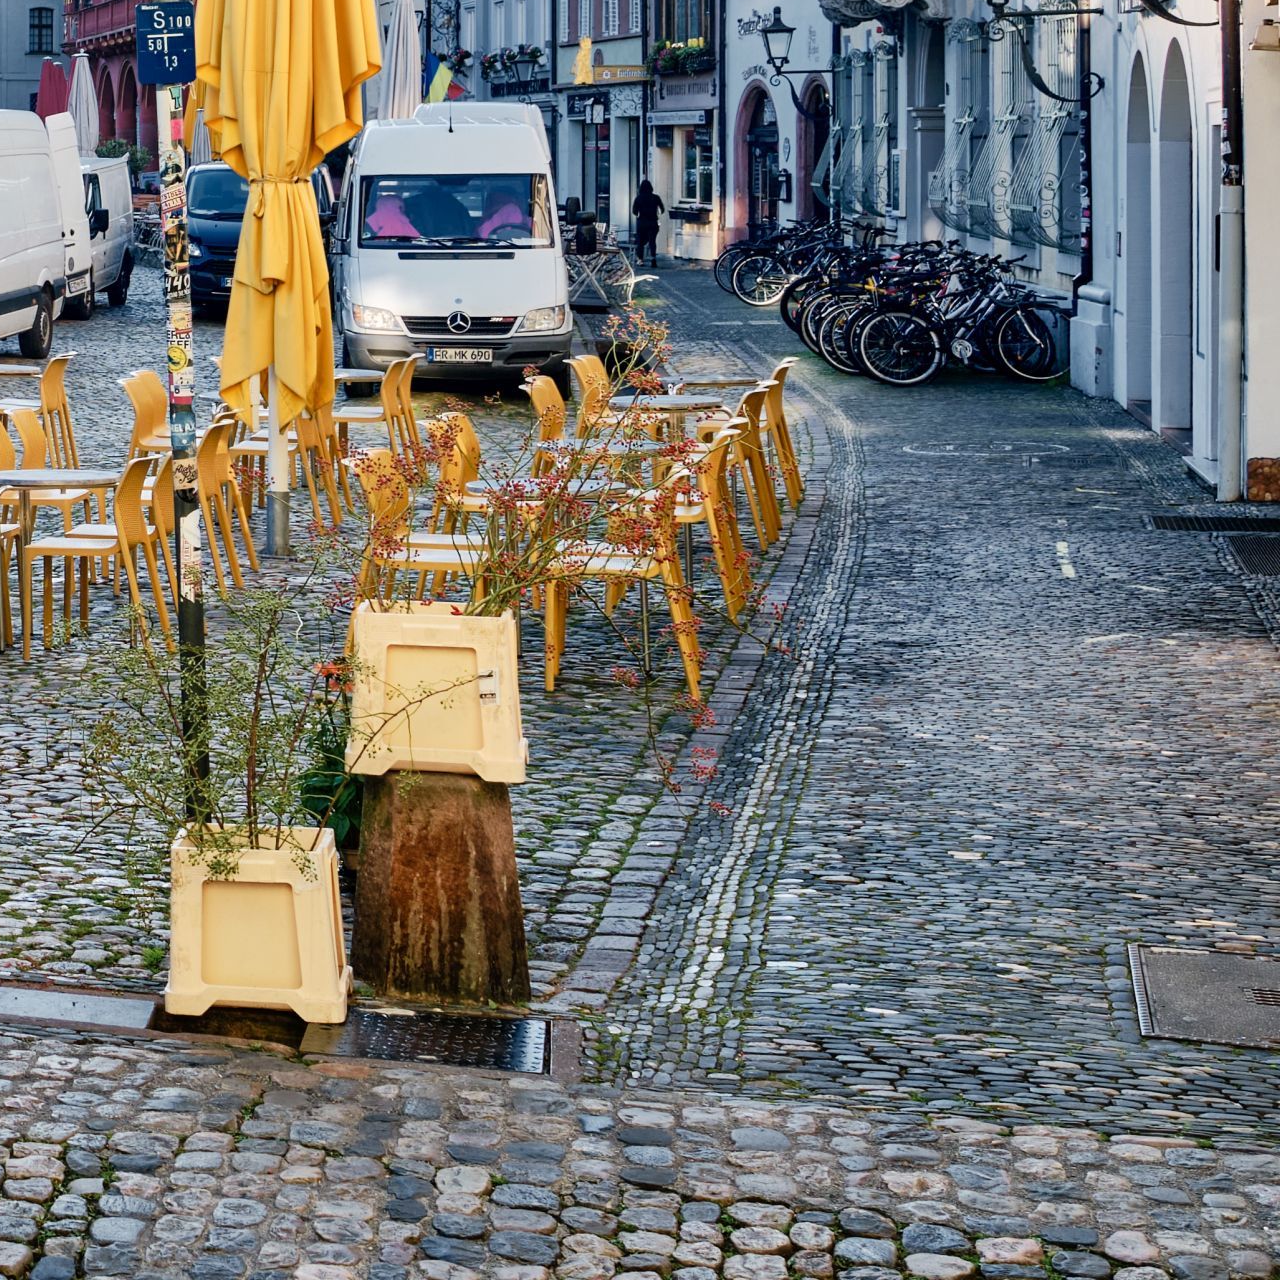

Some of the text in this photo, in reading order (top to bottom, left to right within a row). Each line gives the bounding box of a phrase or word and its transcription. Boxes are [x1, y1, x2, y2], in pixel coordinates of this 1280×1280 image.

[153, 11, 192, 29] S 100
[434, 350, 491, 360] FR MK 690
